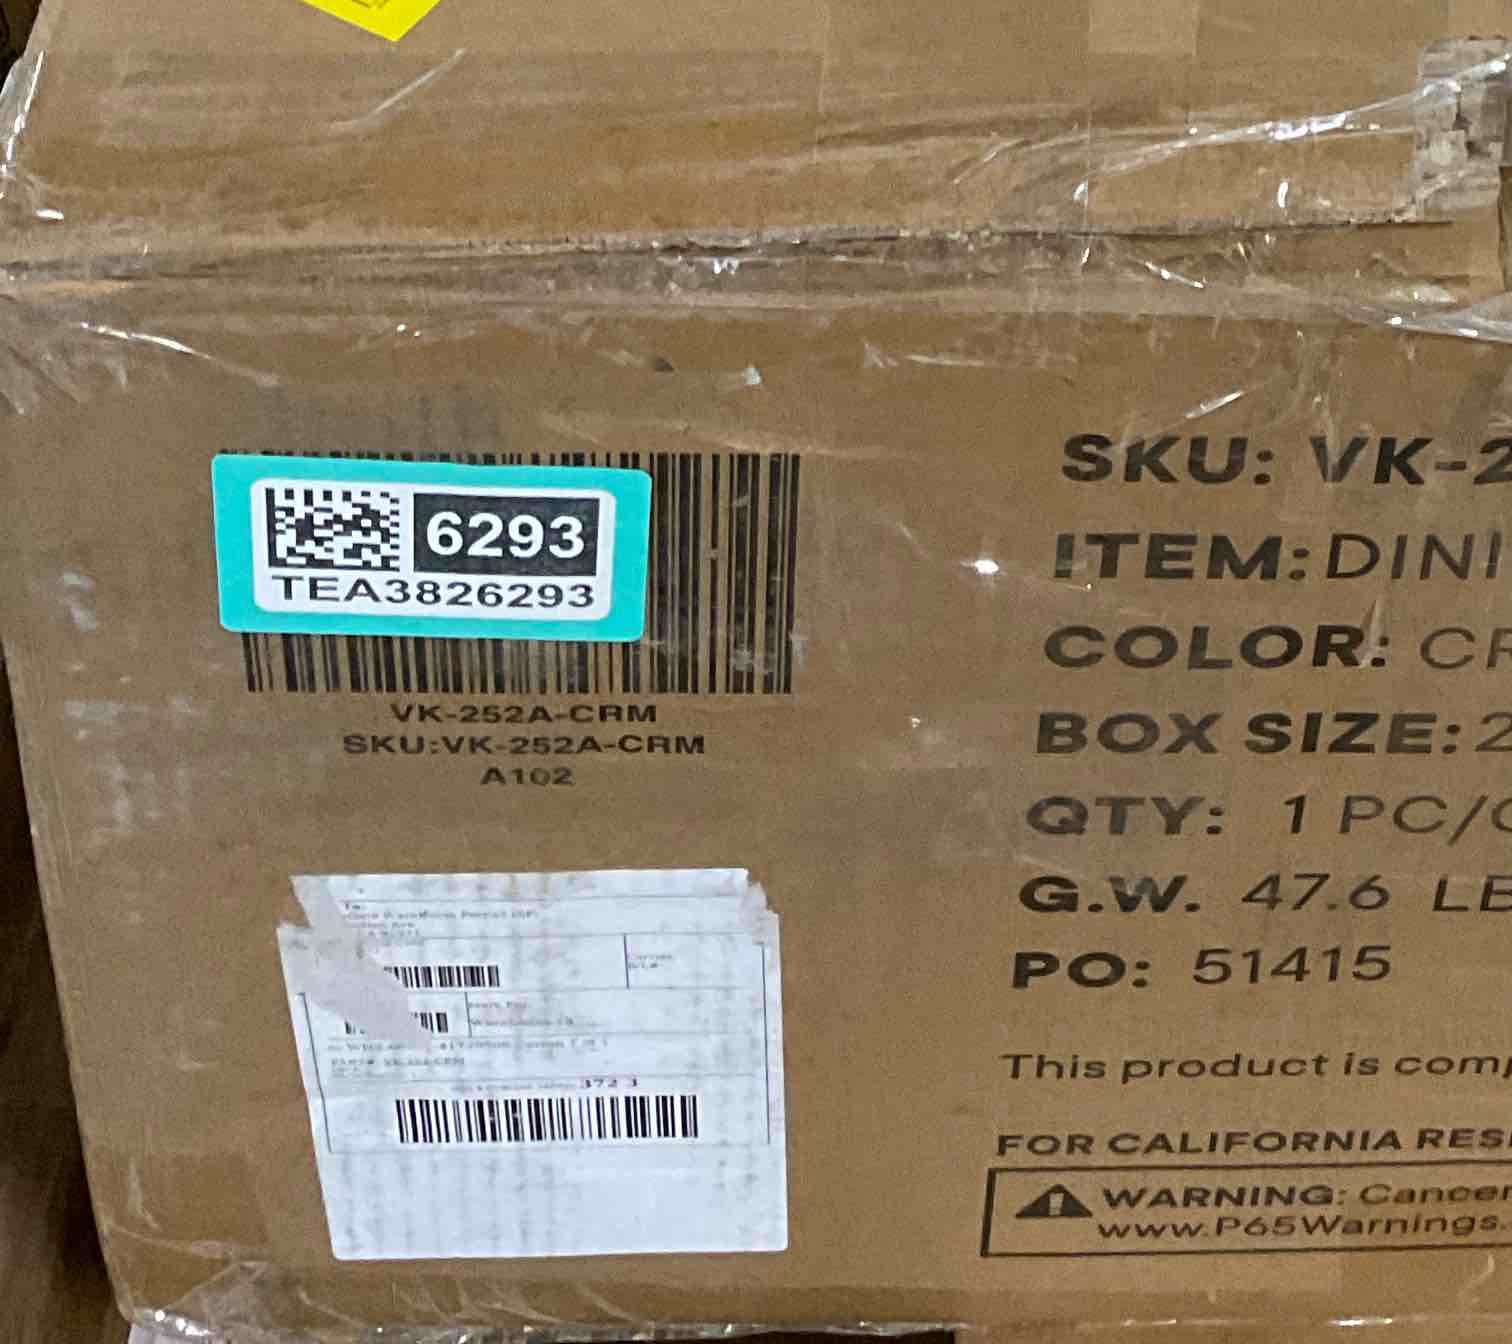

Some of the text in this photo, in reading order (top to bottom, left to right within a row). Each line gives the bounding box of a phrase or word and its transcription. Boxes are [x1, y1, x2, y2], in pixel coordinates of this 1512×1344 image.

[1062, 432, 1274, 485] SKU:
[426, 511, 586, 559] 6293
[271, 574, 596, 609] TEA3826293
[1043, 624, 1390, 670] COLOR:
[390, 703, 658, 724] VK-252A-CRM
[1036, 711, 1225, 754] BOX
[343, 734, 706, 755] SKU:VK-252A-CRM
[480, 767, 576, 787] A102
[1025, 795, 1226, 835] QTY:
[1281, 793, 1309, 833] 1
[1018, 874, 1201, 913] G.W.
[1241, 872, 1391, 912] 47.6
[1012, 944, 1392, 989] PO: 51415
[1000, 1052, 1106, 1080] This
[1121, 1052, 1329, 1085] product
[1343, 1050, 1380, 1077] is
[996, 1133, 1096, 1157] FOR
[1106, 1127, 1404, 1157] CALIFORNIA
[1101, 1183, 1347, 1210] WARNING:
